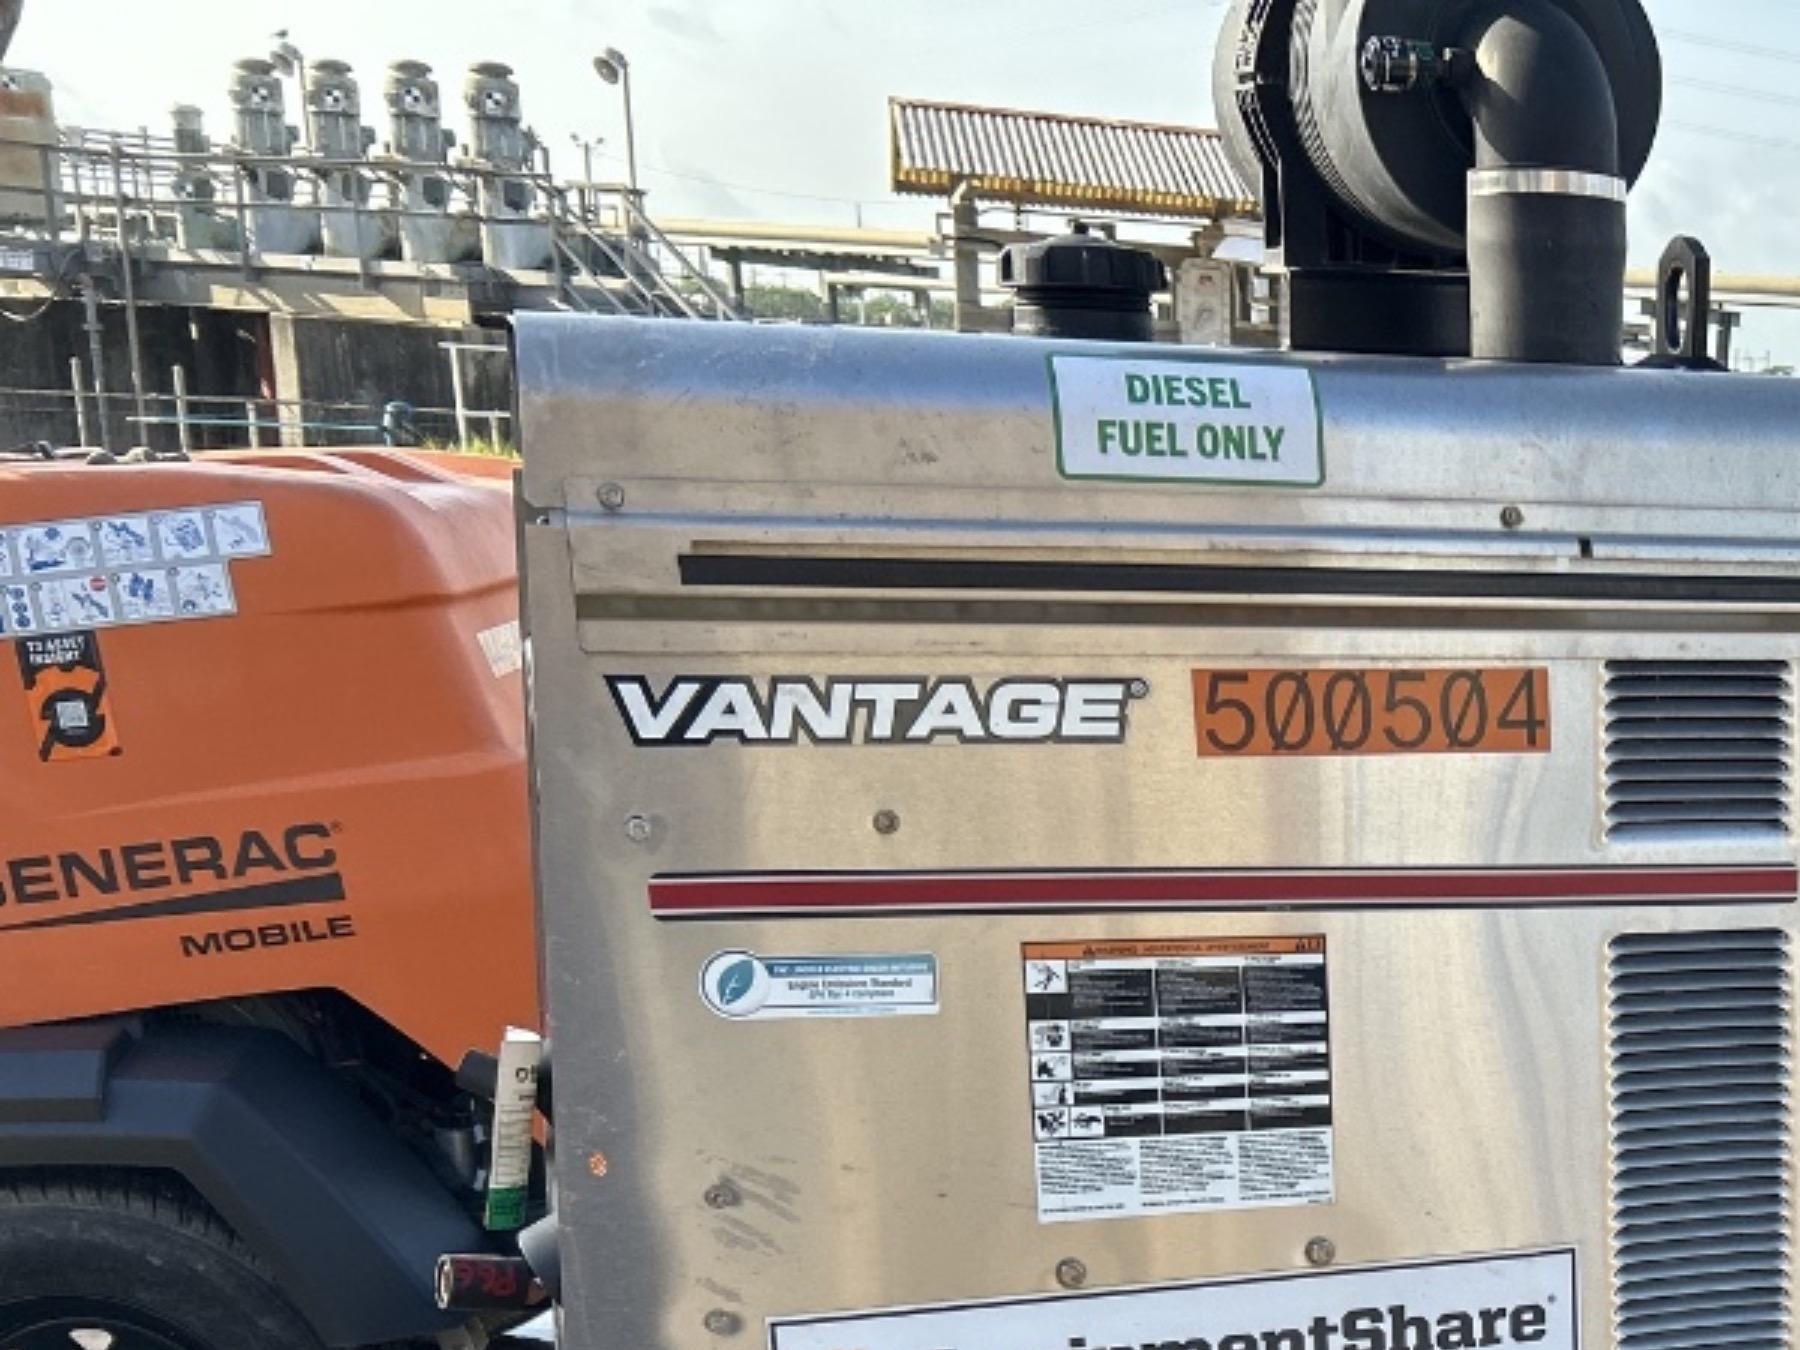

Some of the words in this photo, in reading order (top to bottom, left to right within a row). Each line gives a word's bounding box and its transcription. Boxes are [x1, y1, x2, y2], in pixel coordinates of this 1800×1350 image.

[1125, 374, 1251, 408] DIESEL
[1097, 420, 1188, 457] FUEL
[1196, 425, 1285, 461] ONLY
[603, 674, 1128, 746] VANTAGE
[1204, 668, 1546, 752] 500504
[0, 823, 337, 906] ENERAC
[180, 915, 356, 958] MOBILE
